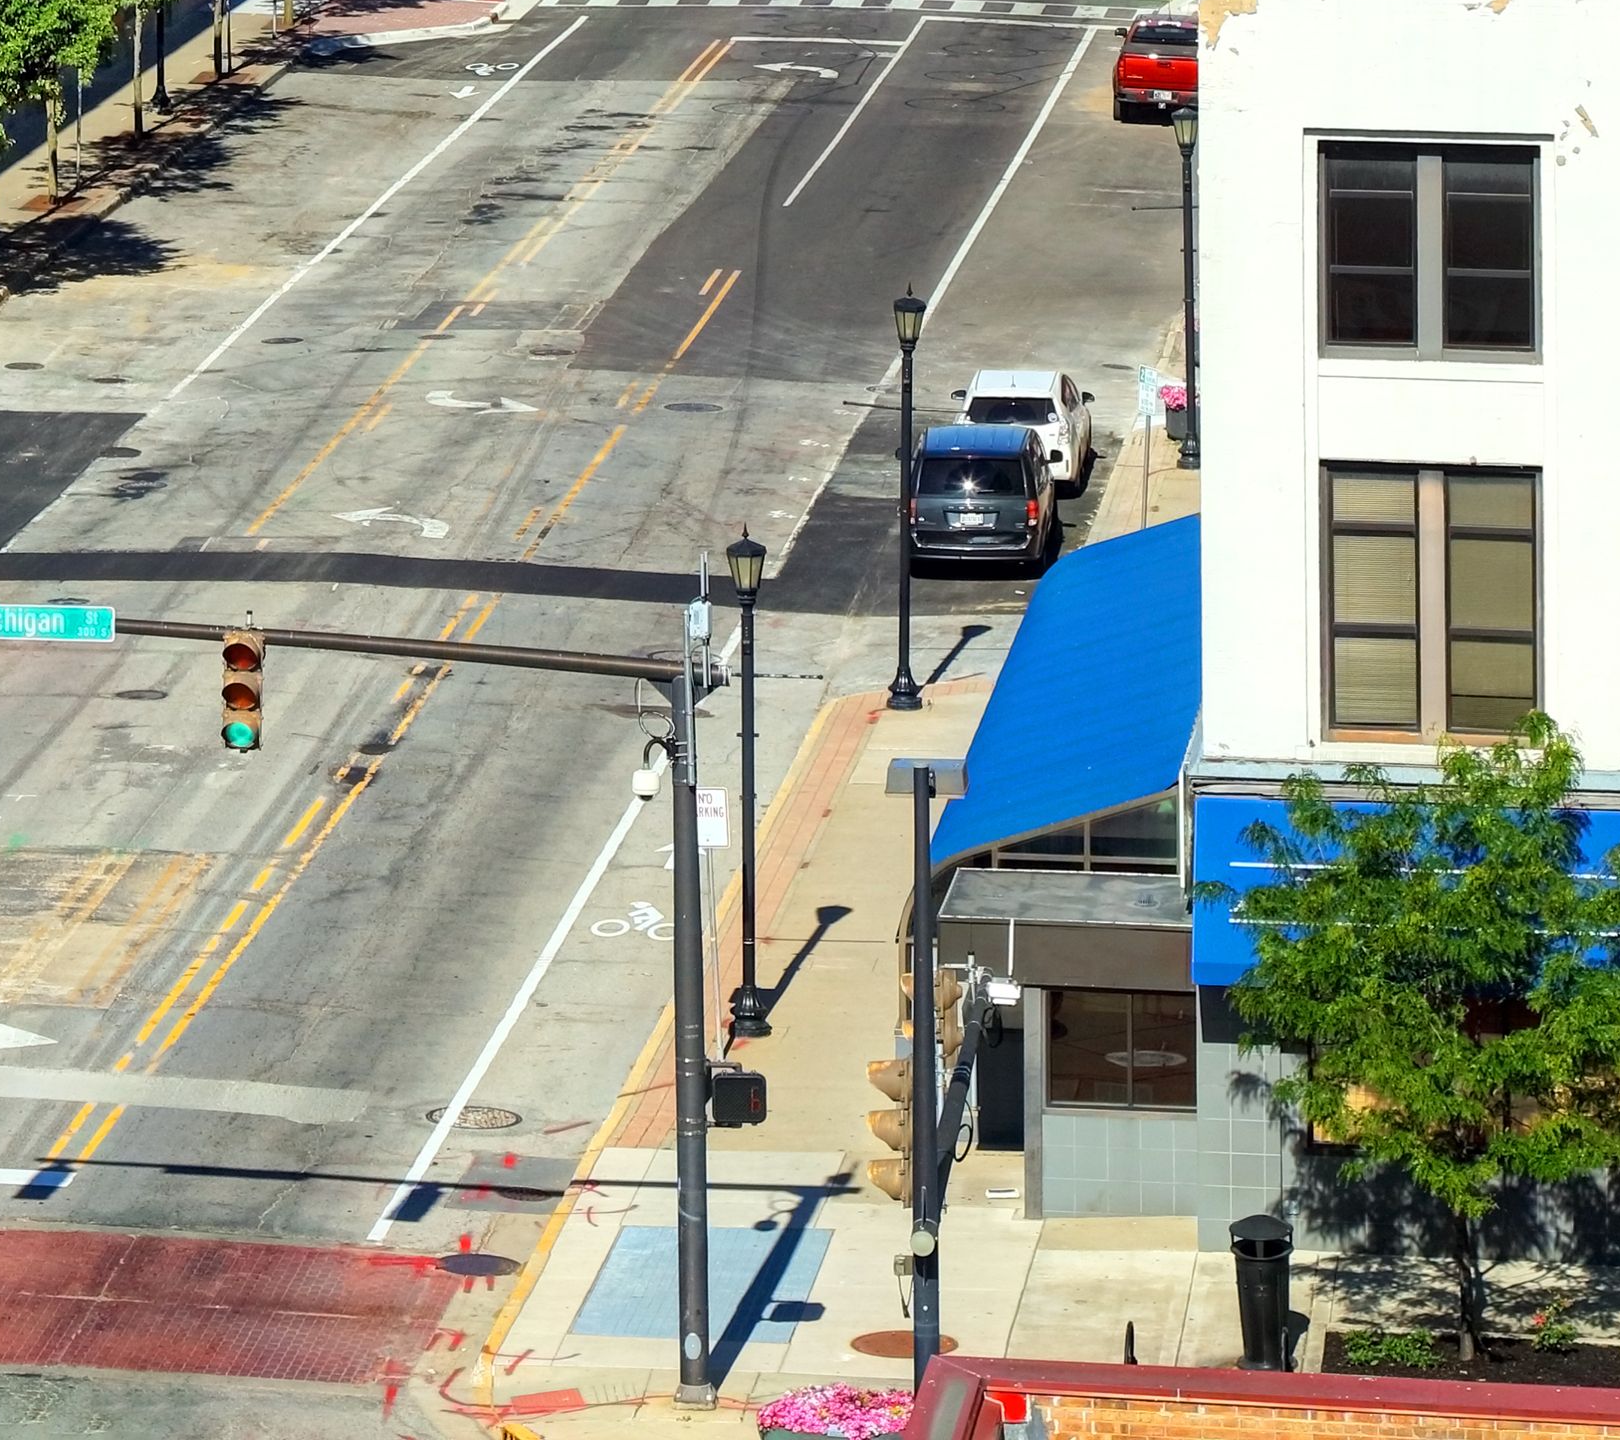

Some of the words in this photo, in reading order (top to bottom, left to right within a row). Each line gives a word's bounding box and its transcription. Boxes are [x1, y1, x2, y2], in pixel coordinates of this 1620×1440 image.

[85, 611, 99, 625] St
[77, 627, 96, 637] 300
[698, 793, 713, 804] NO
[698, 806, 724, 818] RKING
